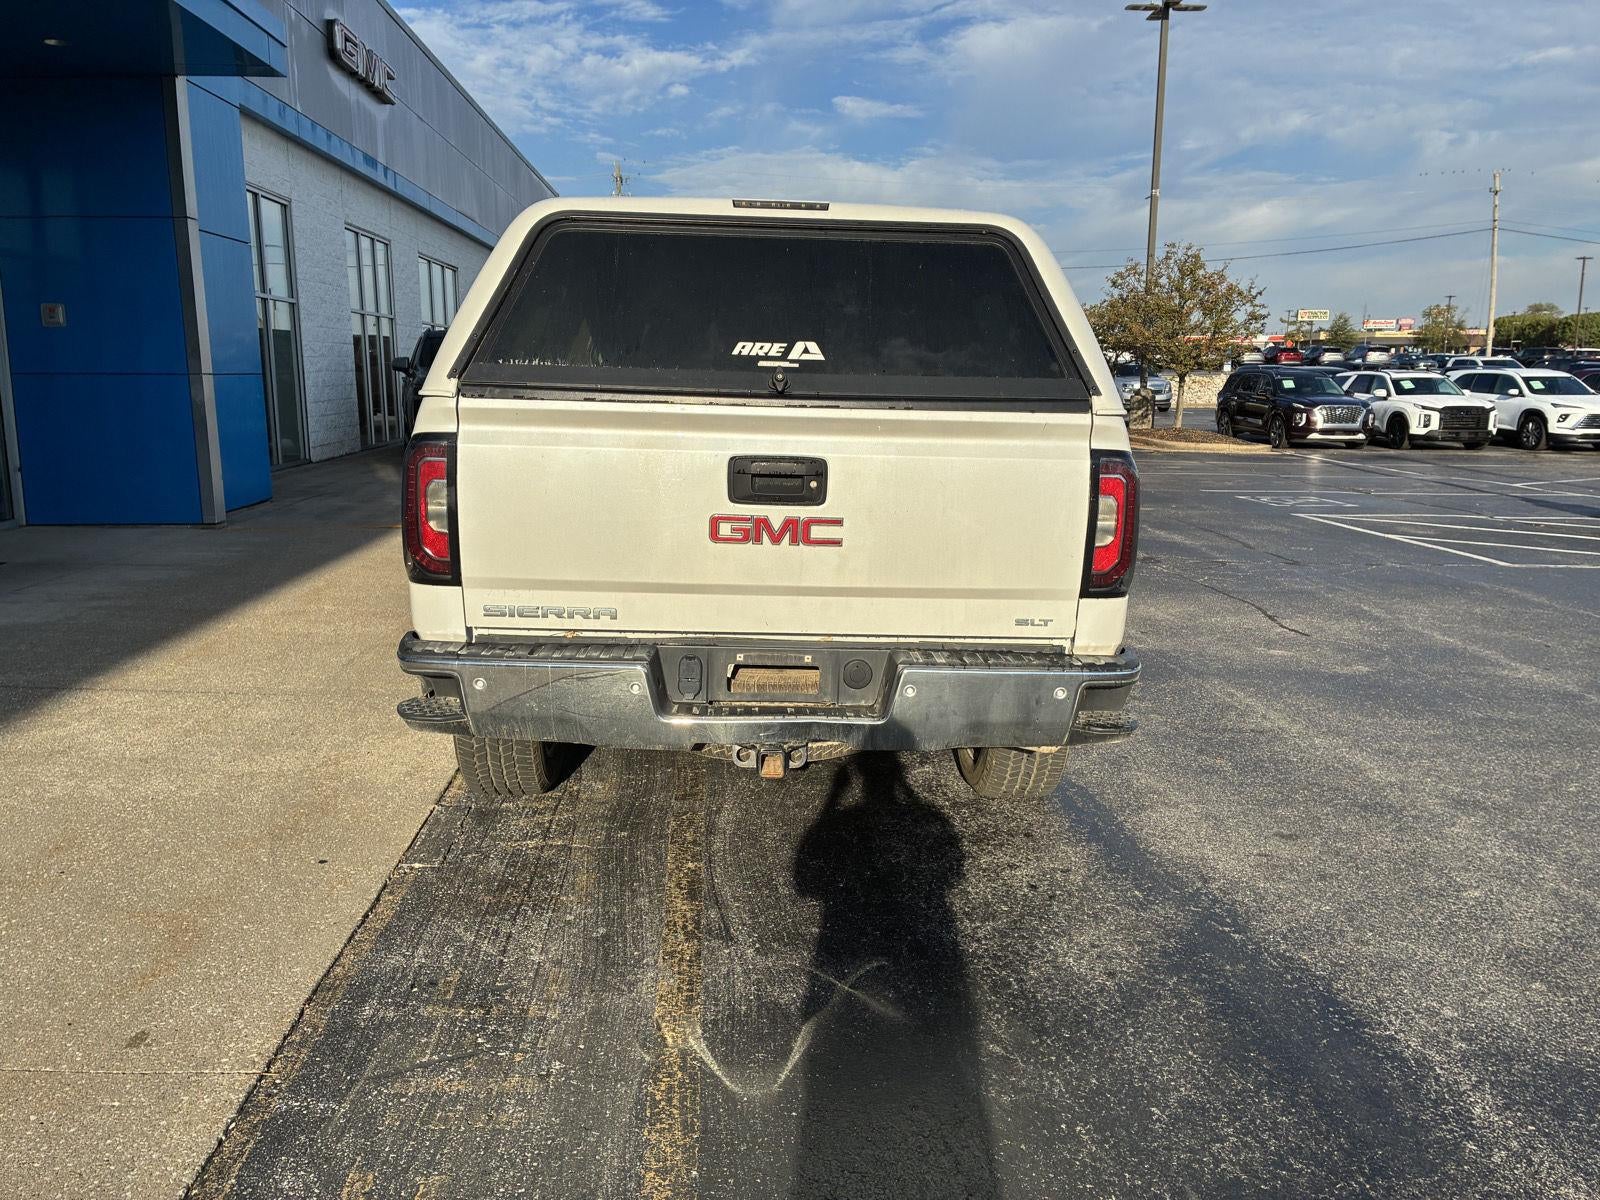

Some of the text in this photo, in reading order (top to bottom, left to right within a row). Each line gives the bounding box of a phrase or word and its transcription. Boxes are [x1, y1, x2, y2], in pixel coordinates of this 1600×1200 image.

[331, 19, 399, 105] GMC
[731, 341, 788, 356] ARE
[709, 513, 844, 547] GMC
[483, 604, 618, 621] SIERRA
[1015, 618, 1054, 627] SLT
